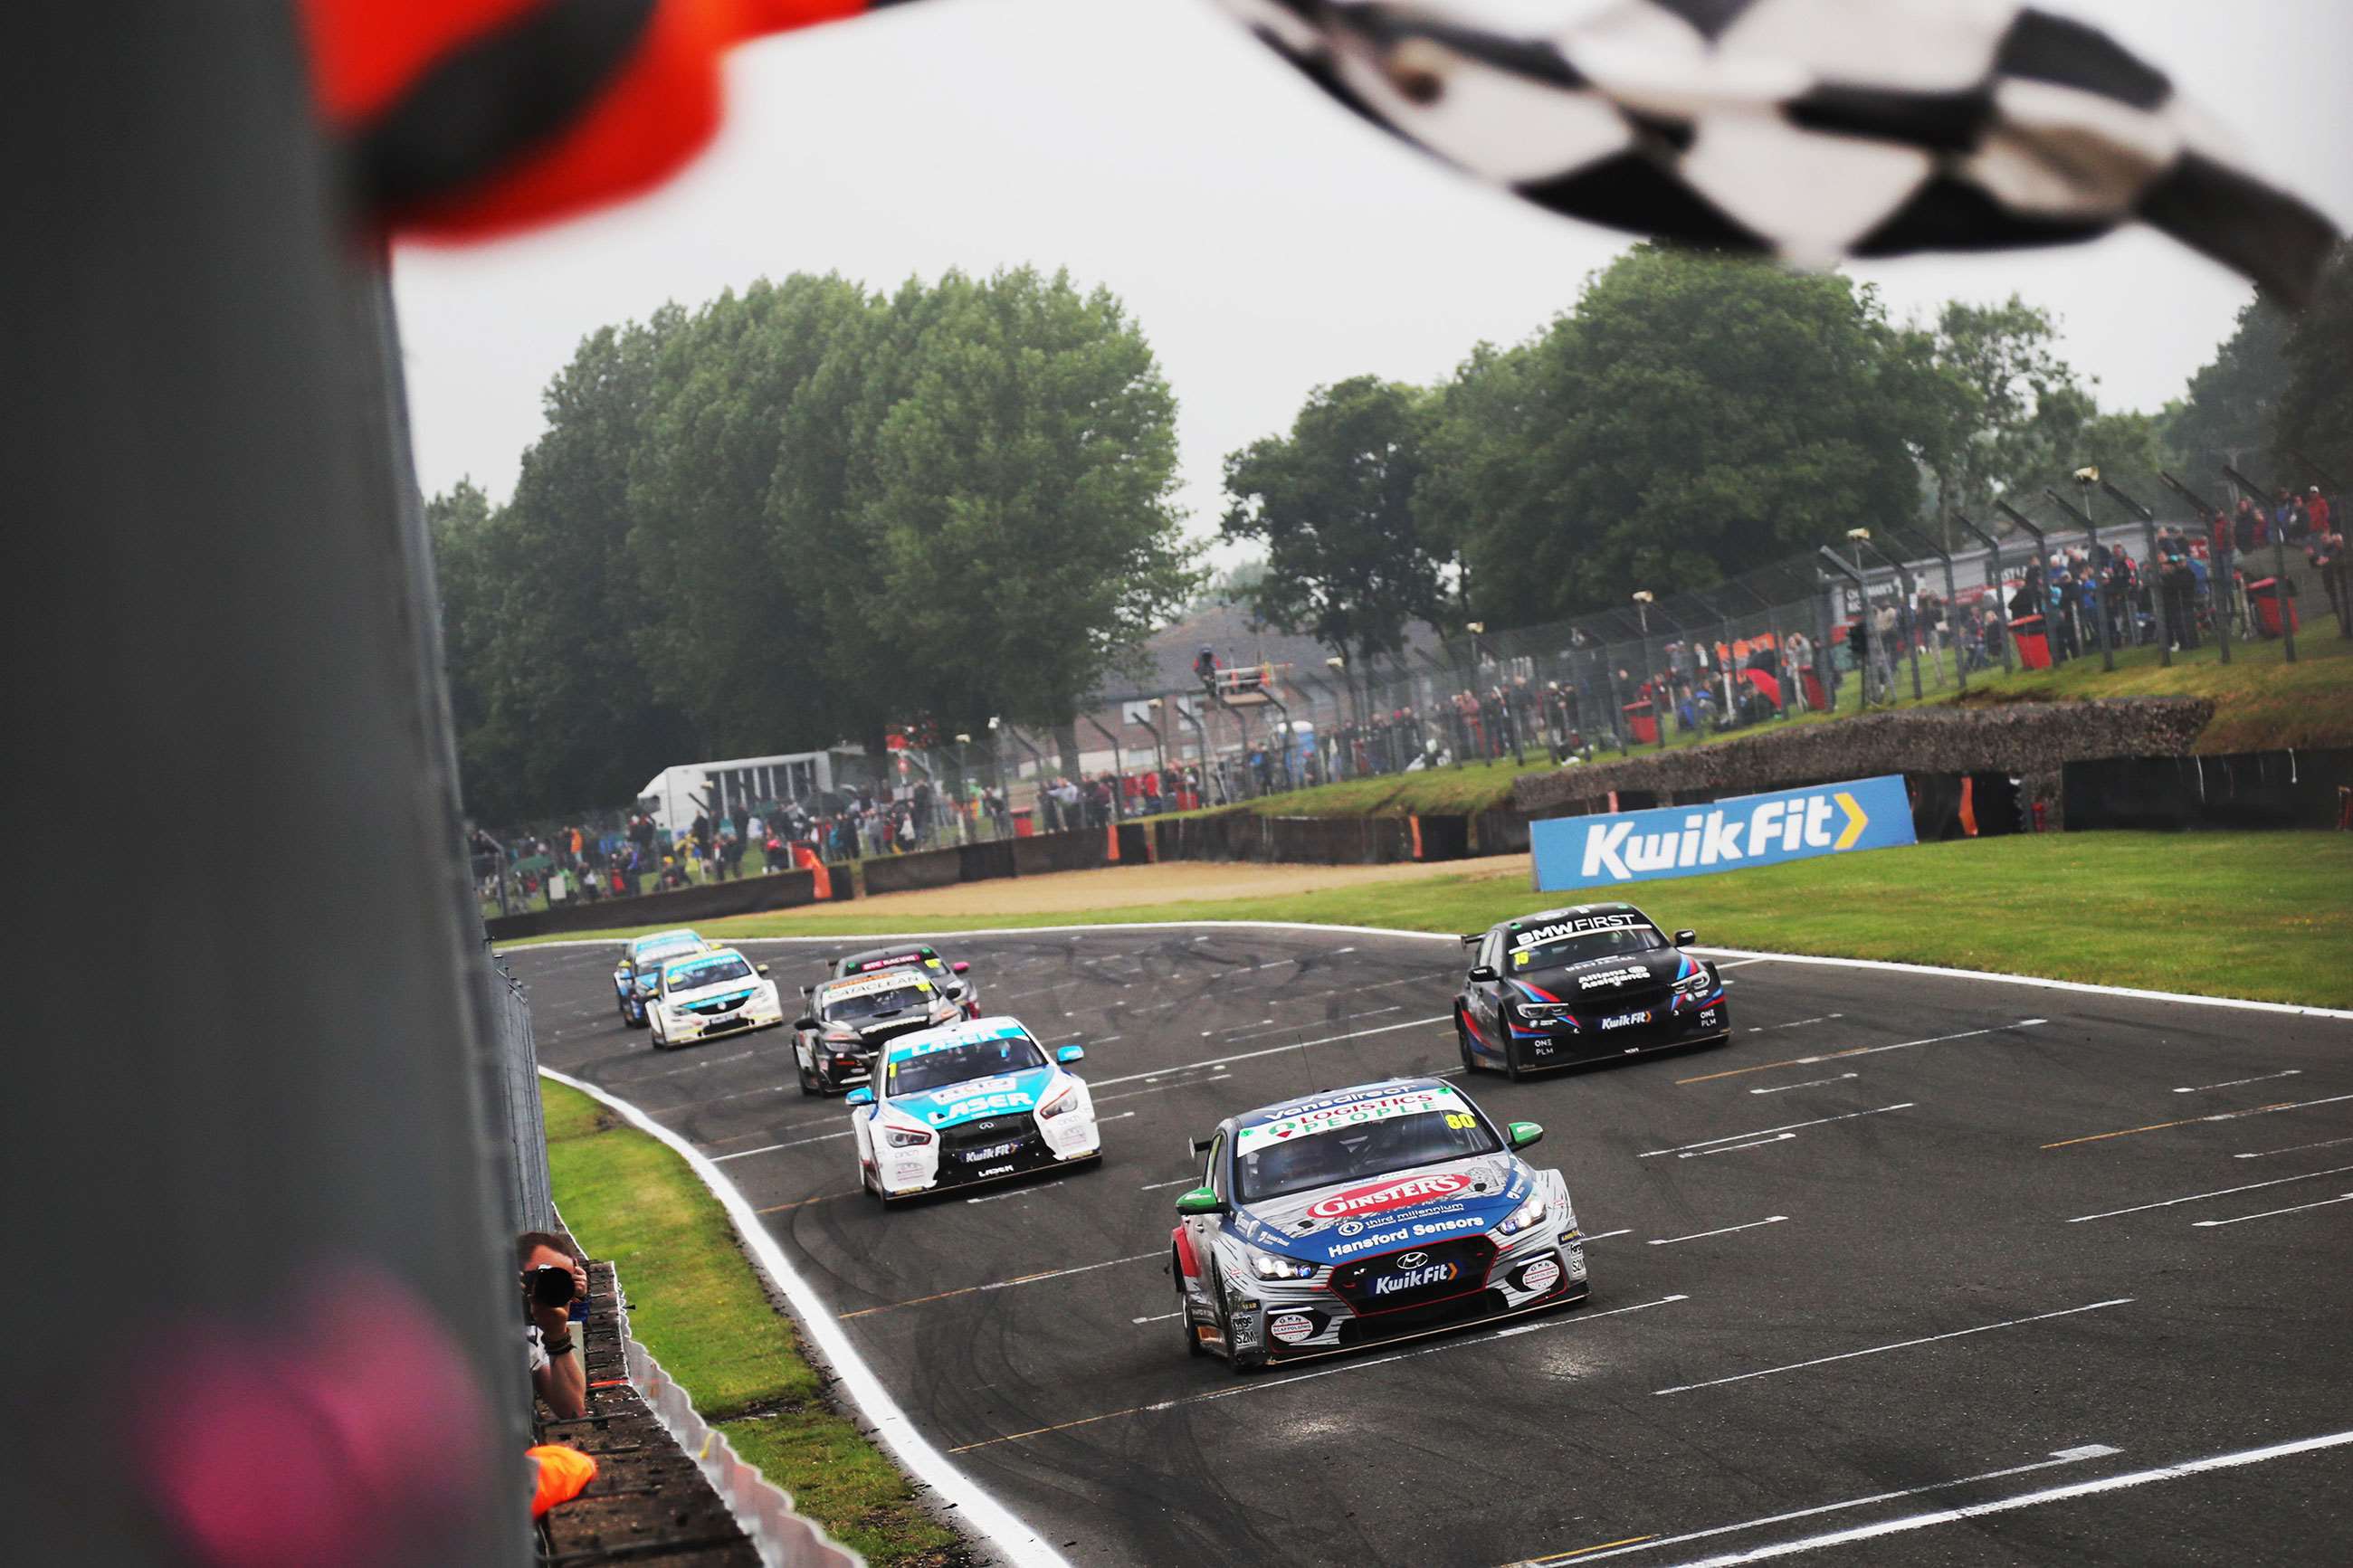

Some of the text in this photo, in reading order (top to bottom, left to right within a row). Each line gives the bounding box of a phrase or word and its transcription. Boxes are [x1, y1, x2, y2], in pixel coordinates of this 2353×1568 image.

[911, 1030, 1002, 1056] LASER
[927, 1092, 1034, 1125] LASER
[1300, 1093, 1434, 1124] LOGISTICS
[1305, 1102, 1437, 1133] PEOPLE
[1444, 1114, 1477, 1130] 80
[1328, 1228, 1409, 1258] Hansford
[1414, 1216, 1484, 1236] Sensors
